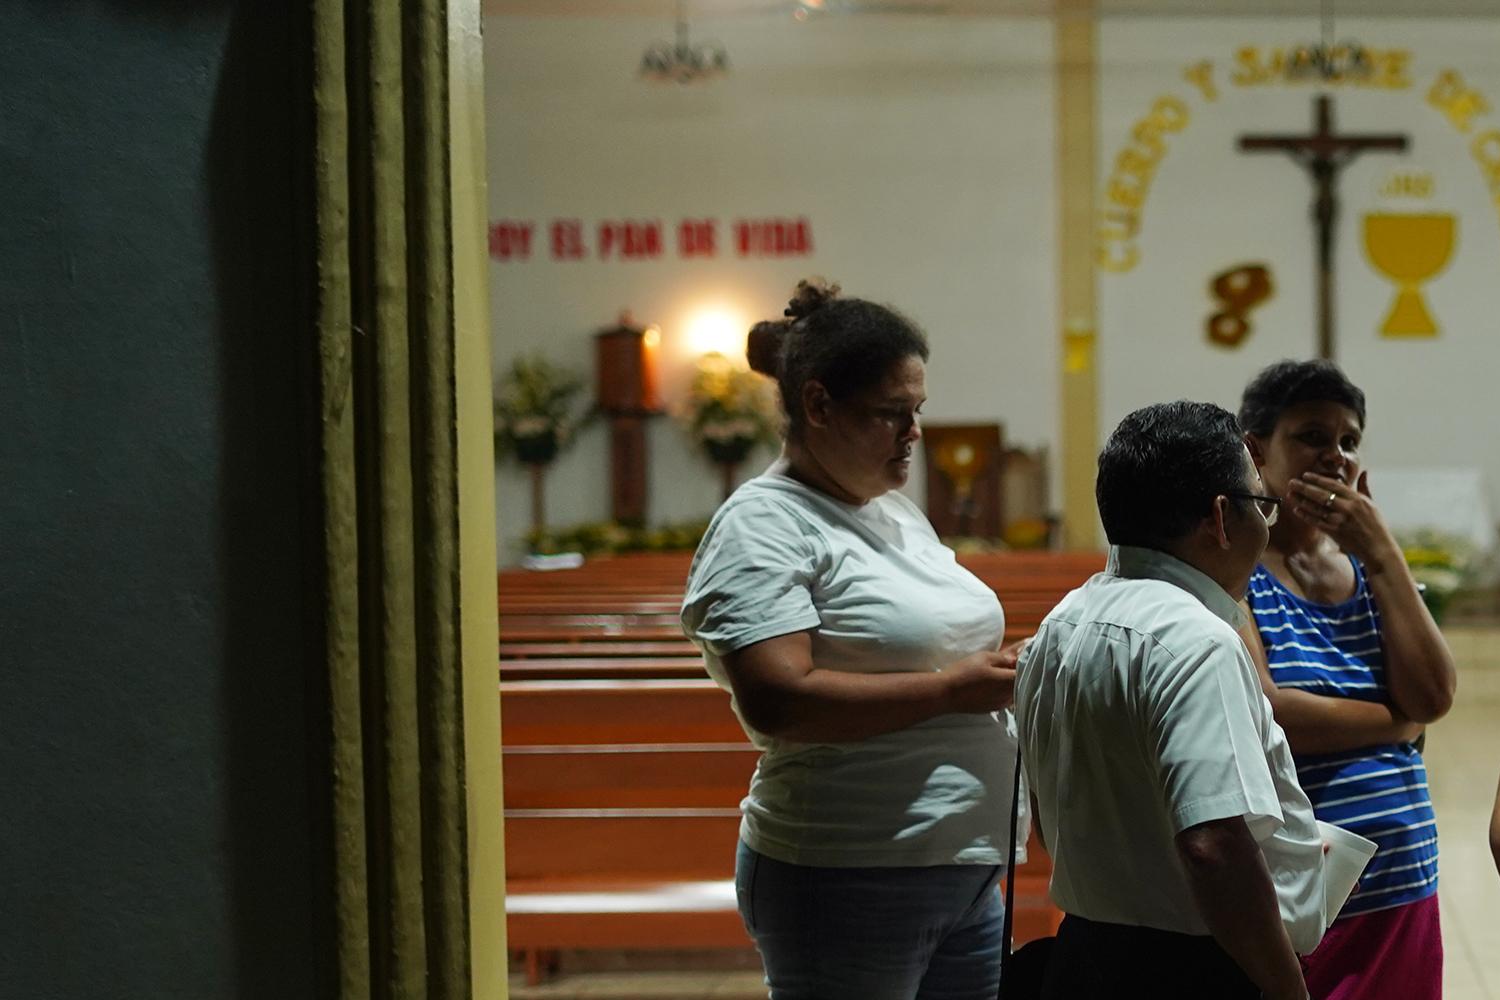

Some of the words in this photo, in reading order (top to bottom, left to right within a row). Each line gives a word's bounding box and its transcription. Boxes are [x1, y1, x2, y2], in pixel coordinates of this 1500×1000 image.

[1097, 94, 1191, 273] CUERPO
[1184, 59, 1216, 101] Y
[1231, 46, 1412, 86] SAGE
[1425, 67, 1494, 133] DE
[550, 218, 586, 259] EL
[598, 218, 662, 258] PAN
[679, 218, 718, 257] DE
[734, 217, 813, 256] VIDA
